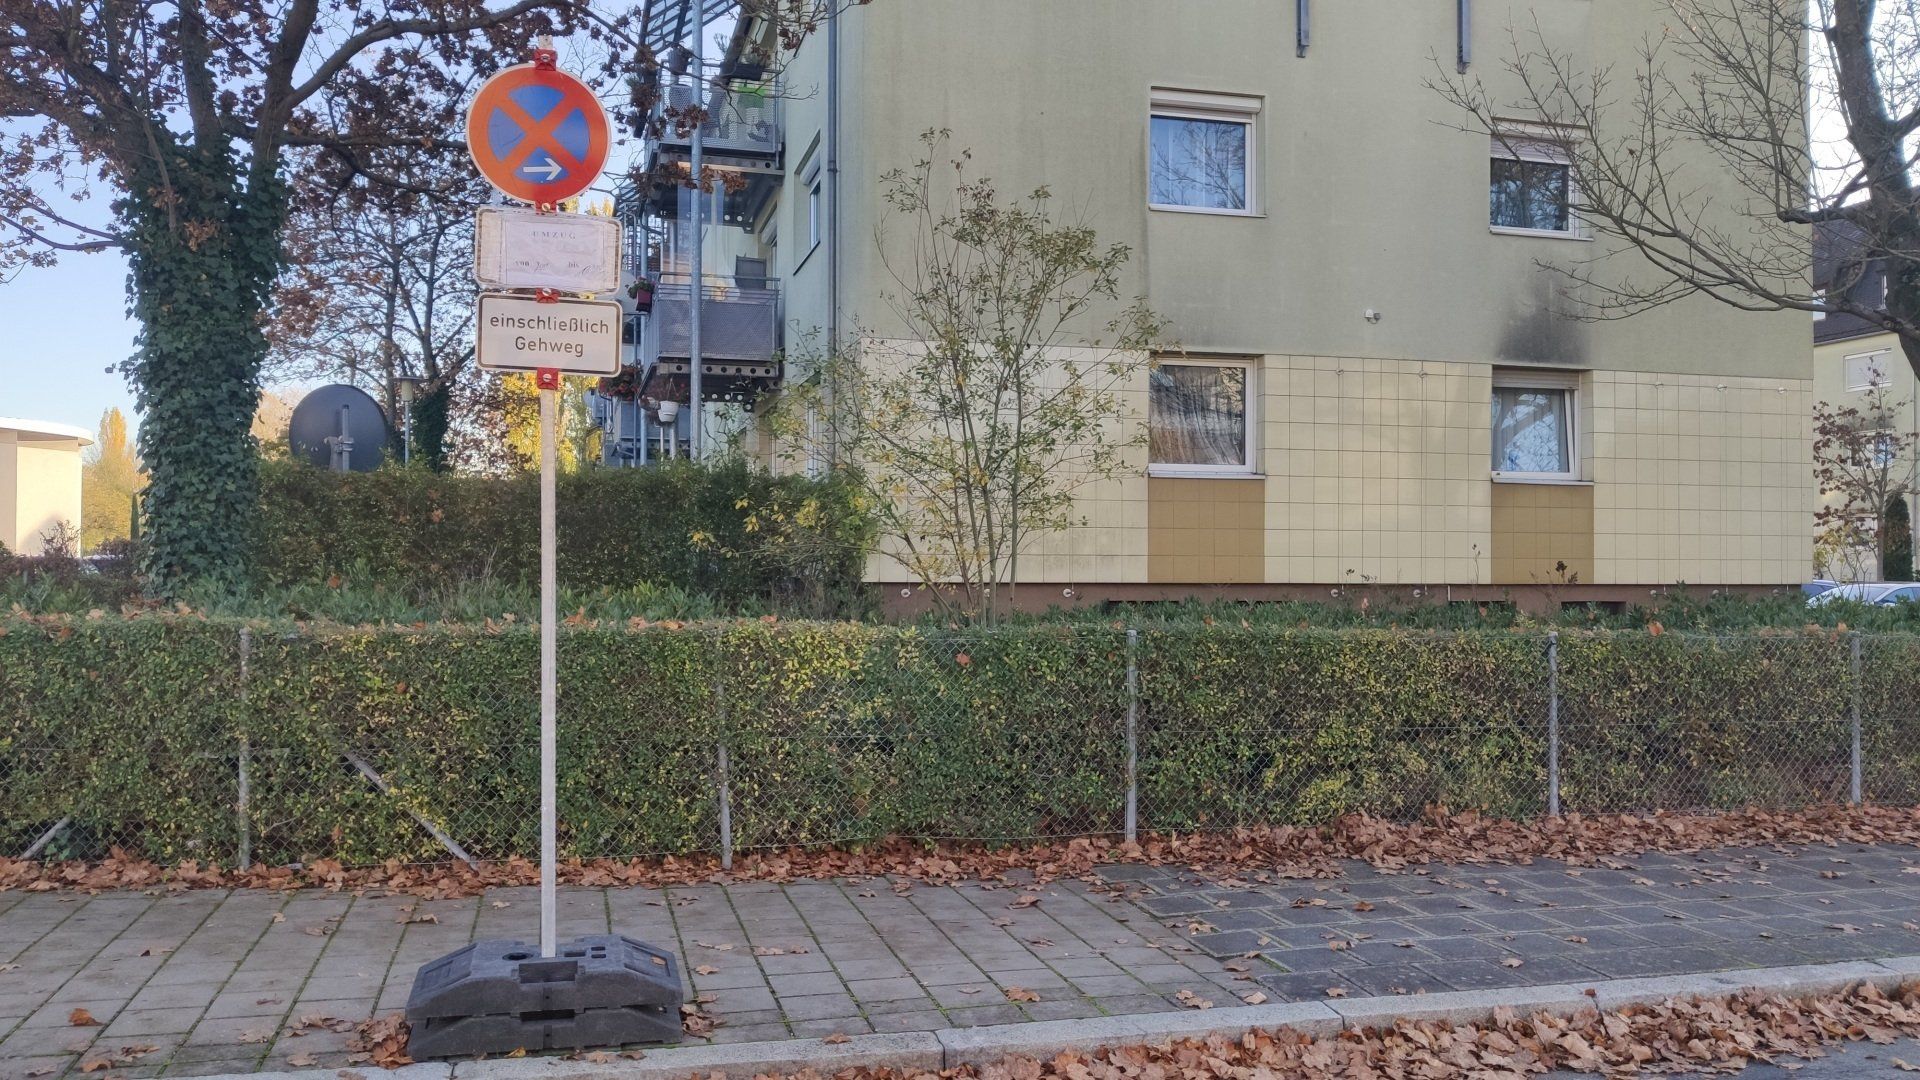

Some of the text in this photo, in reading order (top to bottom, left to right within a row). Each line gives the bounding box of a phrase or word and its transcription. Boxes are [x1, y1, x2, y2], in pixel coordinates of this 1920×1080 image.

[531, 230, 577, 240] UMZUG
[490, 313, 609, 334] einschließlich
[515, 336, 584, 358] Gehweg
